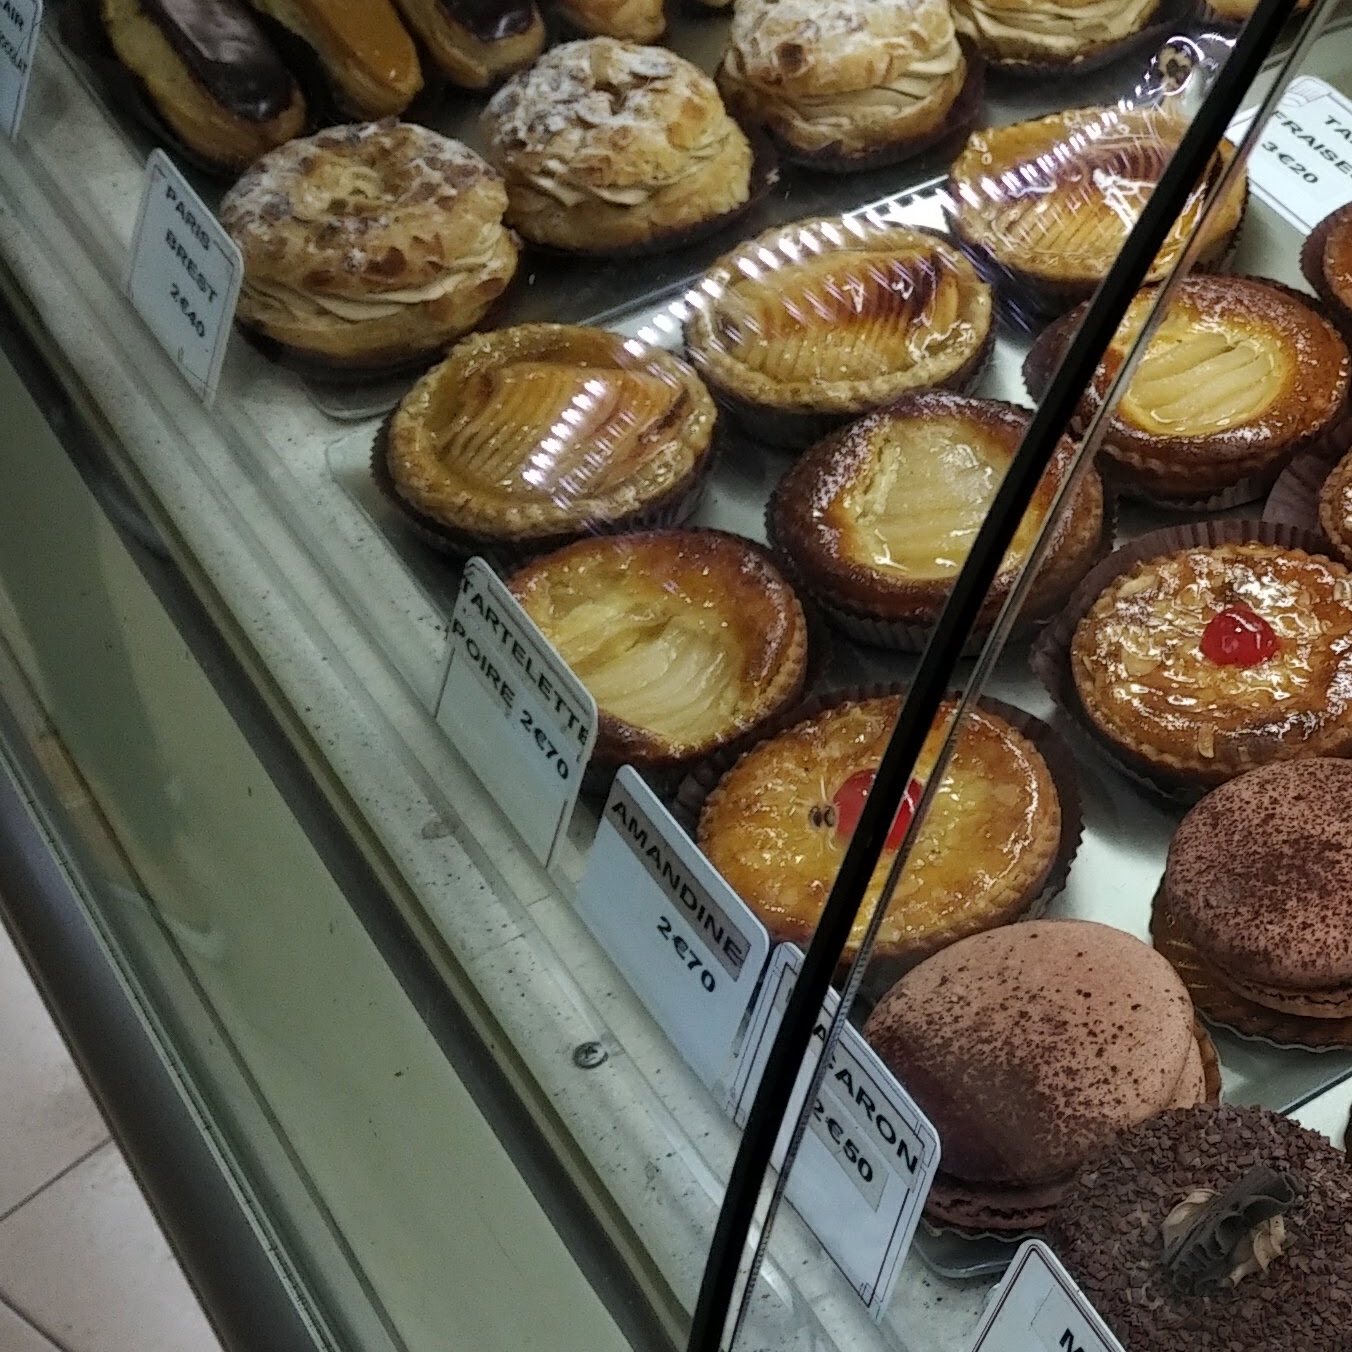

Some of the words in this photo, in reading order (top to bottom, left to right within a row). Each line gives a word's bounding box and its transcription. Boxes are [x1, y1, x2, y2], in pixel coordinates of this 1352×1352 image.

[1261, 140, 1319, 185] 3€20
[165, 184, 210, 251] PARIS
[165, 228, 218, 303] BREST
[170, 282, 205, 338] 2€40
[452, 618, 516, 709] POIRE
[519, 709, 569, 781] 2€70
[462, 578, 589, 746] TARTELETTE
[611, 801, 743, 966] AMANDINE
[656, 915, 716, 993] 2€70
[812, 1098, 873, 1183] 2€50
